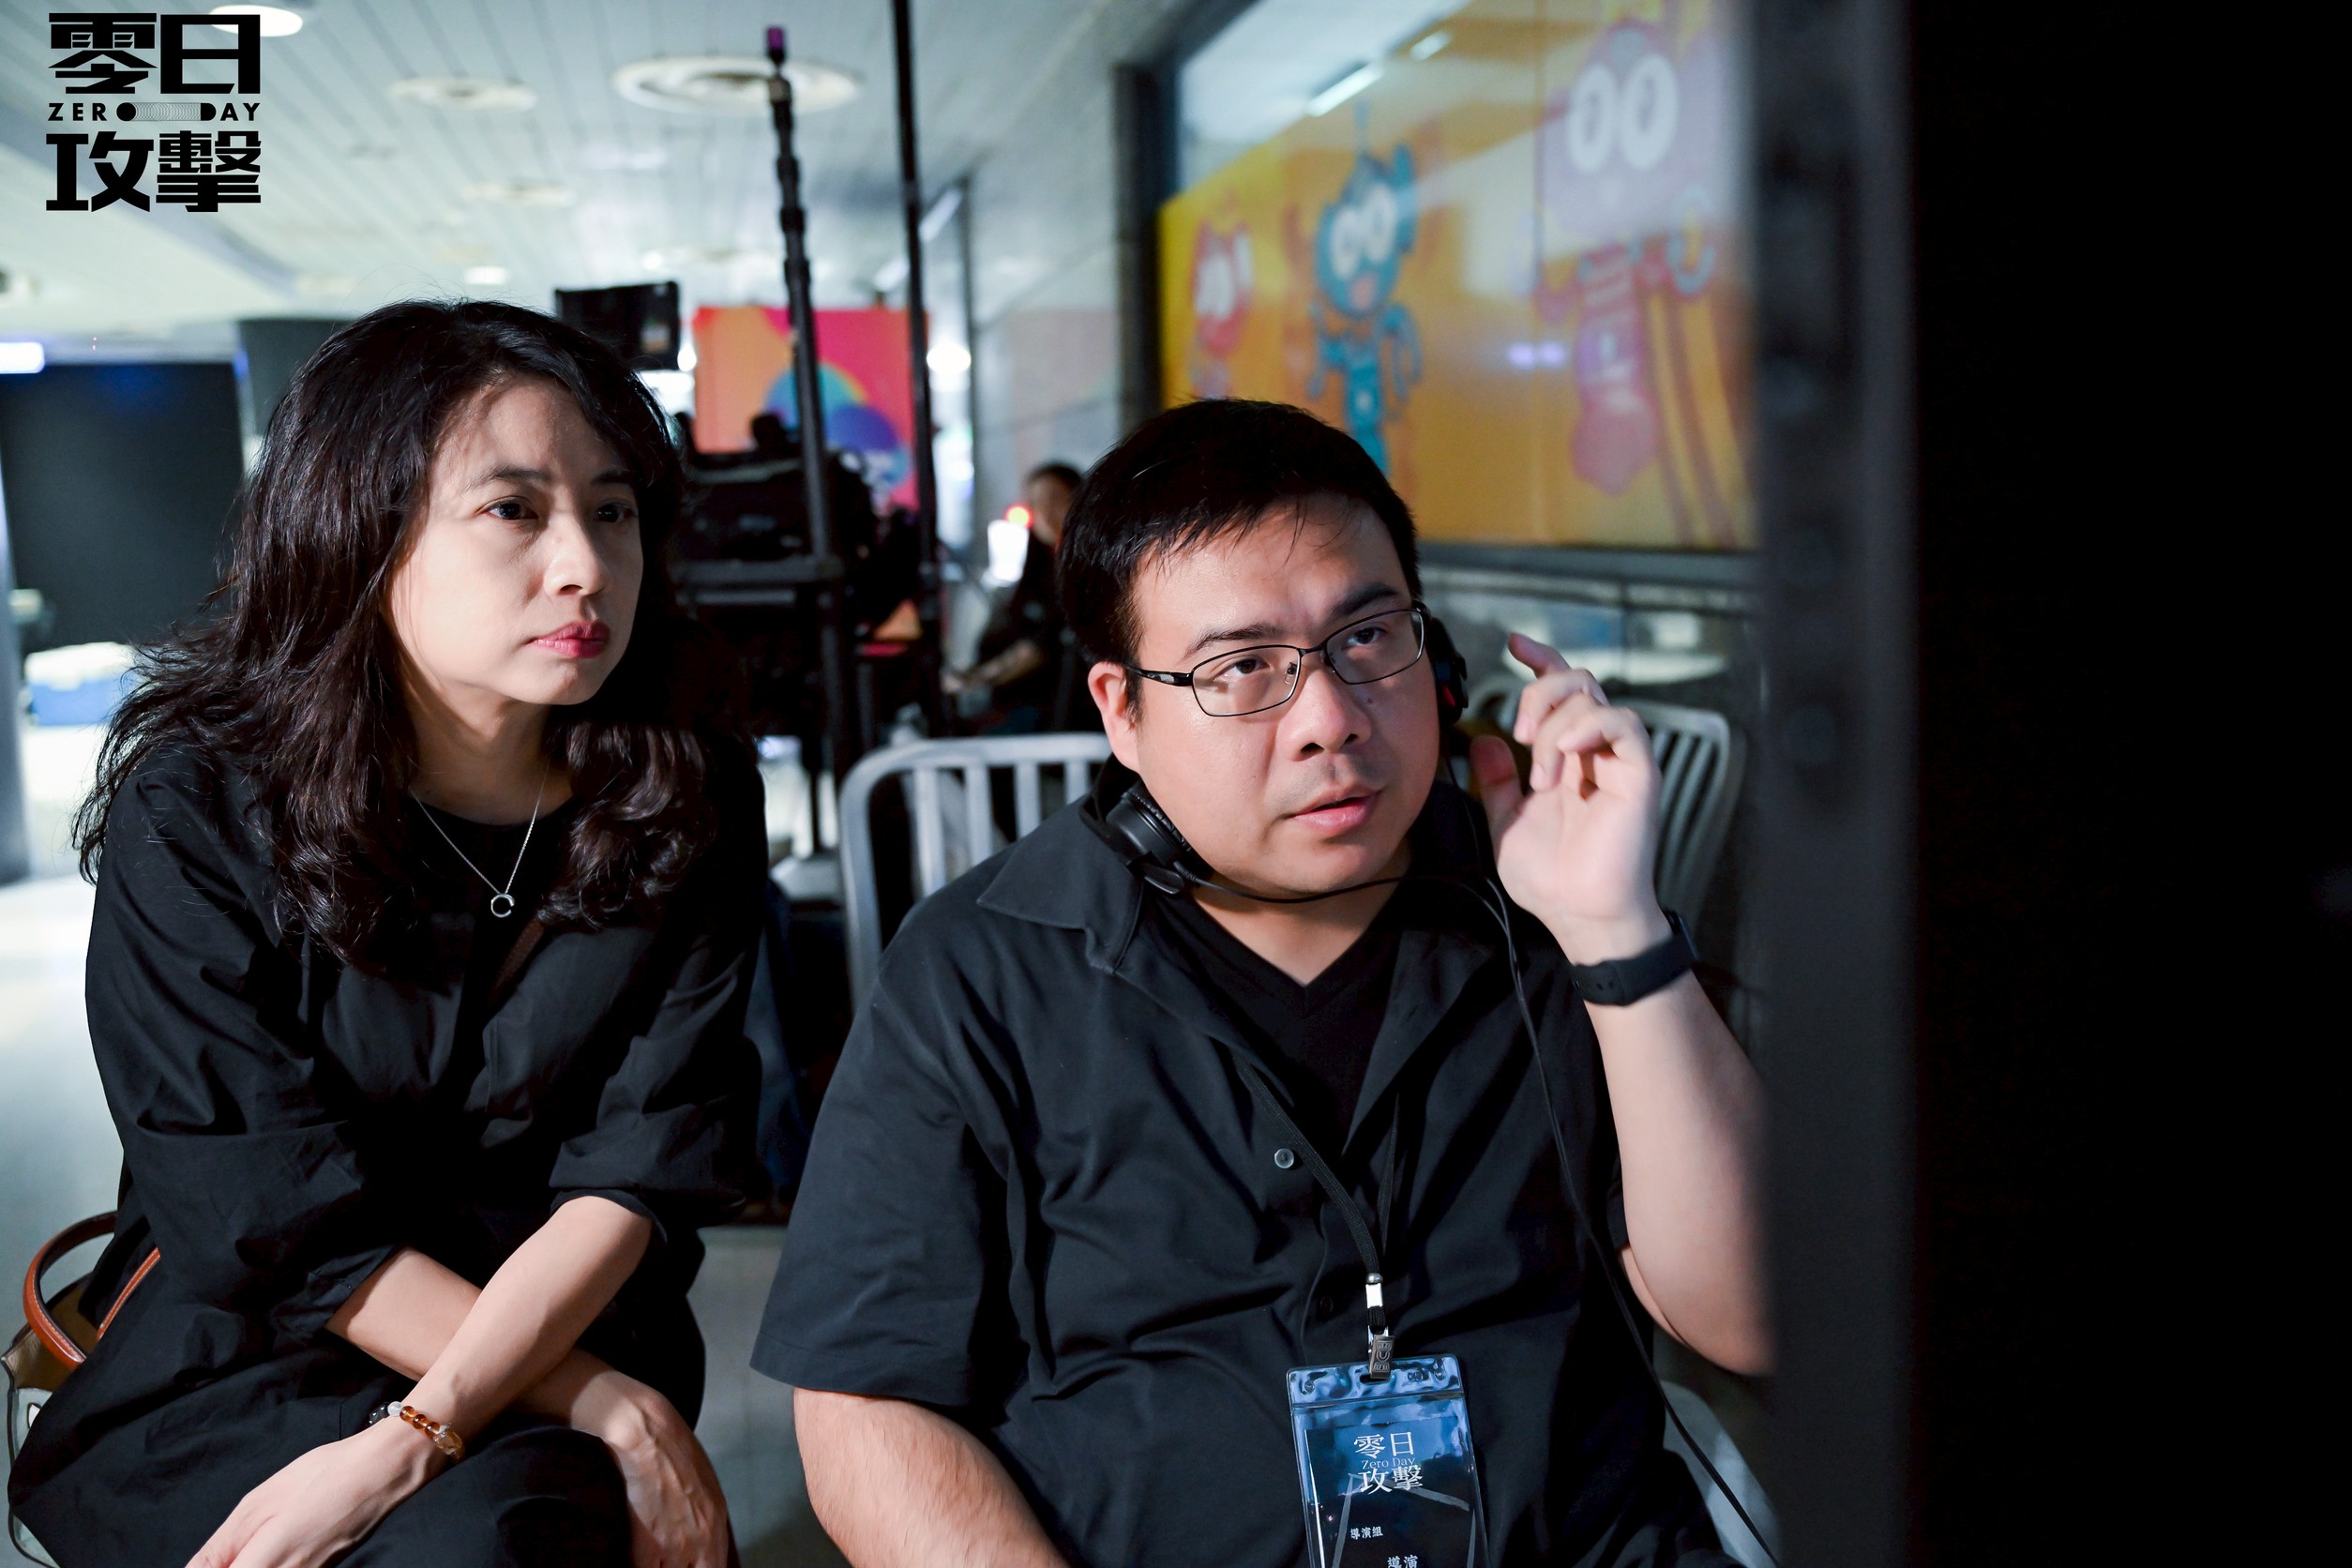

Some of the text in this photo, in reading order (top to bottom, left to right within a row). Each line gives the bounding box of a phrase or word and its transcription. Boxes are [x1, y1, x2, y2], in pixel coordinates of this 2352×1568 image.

[1353, 1431, 1414, 1459] 零日
[1361, 1456, 1415, 1470] Zero Day
[1357, 1464, 1424, 1495] 攻擊
[1350, 1526, 1383, 1540] 導演組
